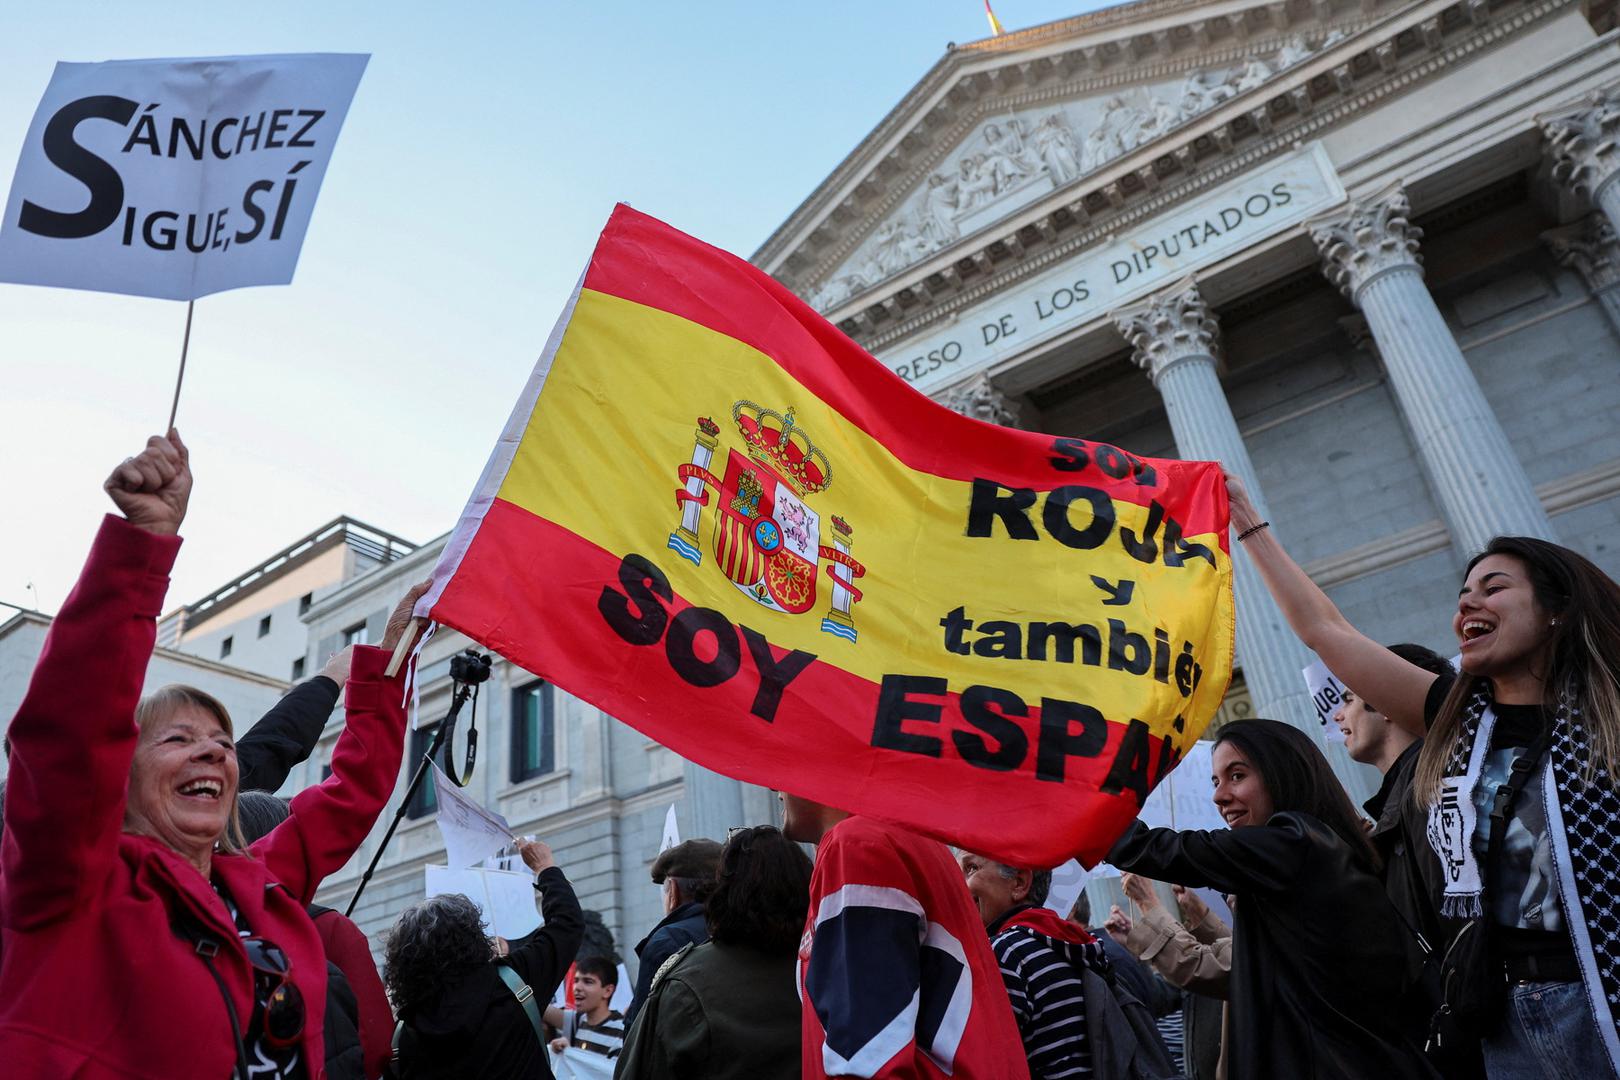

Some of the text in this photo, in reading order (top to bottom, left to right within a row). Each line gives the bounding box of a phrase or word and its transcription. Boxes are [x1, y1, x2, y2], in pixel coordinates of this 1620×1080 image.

[235, 160, 312, 244] SÍ
[981, 314, 1017, 347] DE
[1034, 281, 1090, 320] LOS
[1110, 183, 1292, 284] DIPUTADOS
[686, 465, 713, 484] PLVS
[597, 552, 818, 724] SOY
